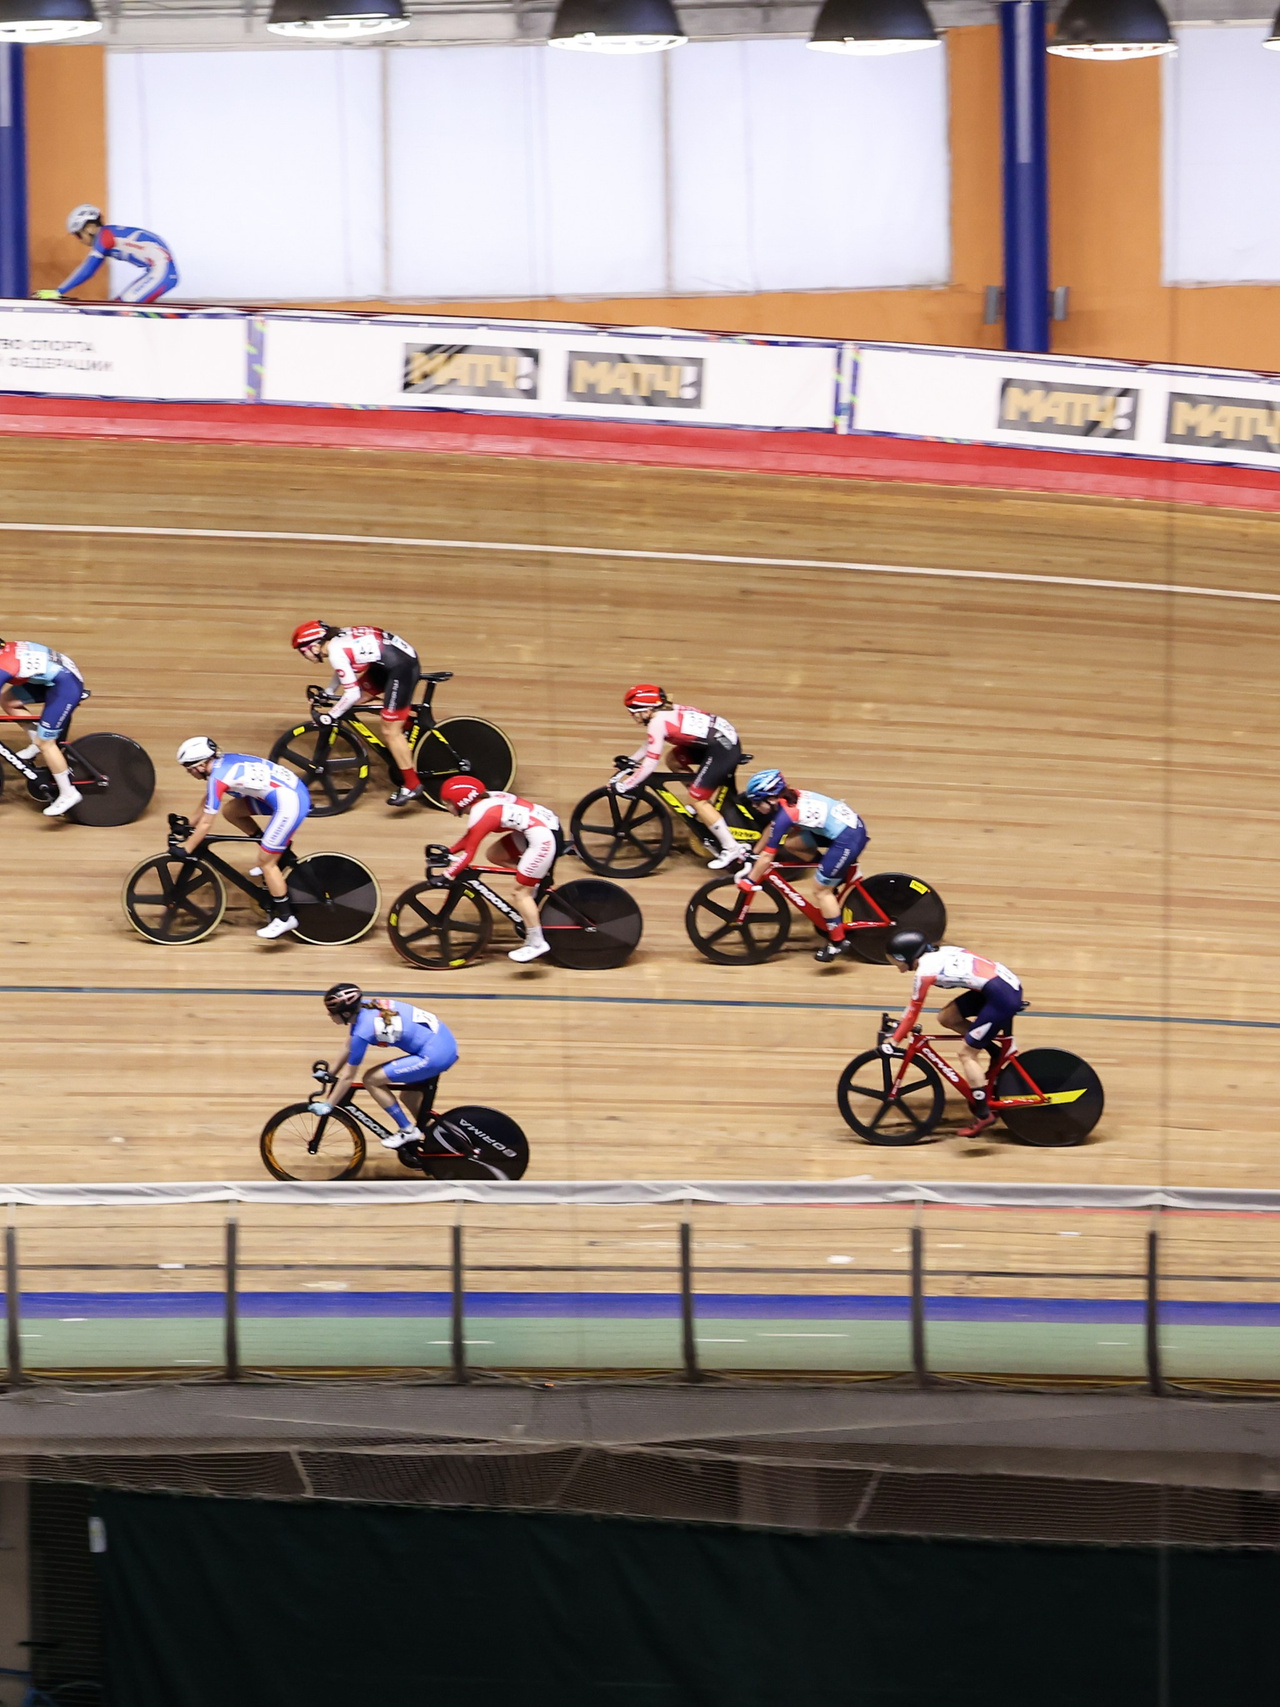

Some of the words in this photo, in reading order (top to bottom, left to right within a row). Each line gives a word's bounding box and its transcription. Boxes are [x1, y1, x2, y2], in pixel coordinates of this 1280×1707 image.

[29, 339, 97, 352] СПОРТА
[9, 357, 115, 372] ФЕДЕРАЦИИ
[467, 879, 511, 913] ARGON
